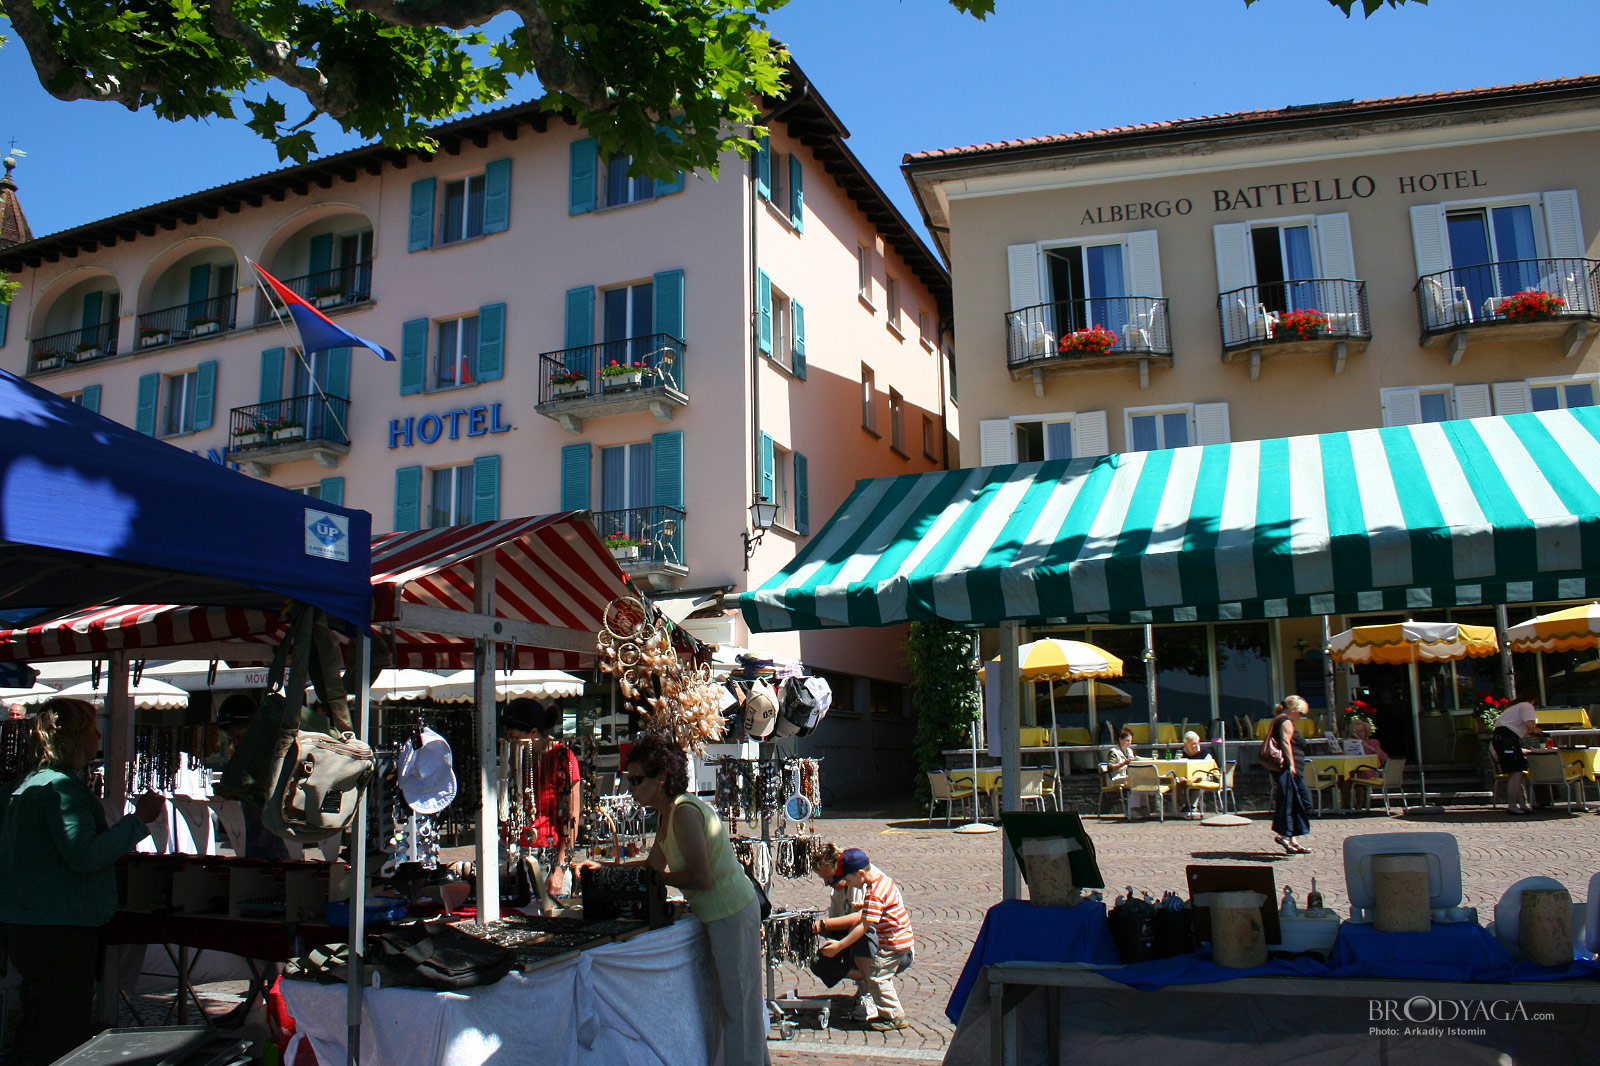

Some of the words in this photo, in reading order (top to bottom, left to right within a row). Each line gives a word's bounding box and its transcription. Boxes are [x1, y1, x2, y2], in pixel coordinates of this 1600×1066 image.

[1080, 197, 1193, 226] ALBERGO
[1212, 174, 1377, 212] BATTELLO
[1399, 168, 1488, 195] HOTEL
[386, 402, 512, 449] HOTEL
[316, 522, 339, 537] UP
